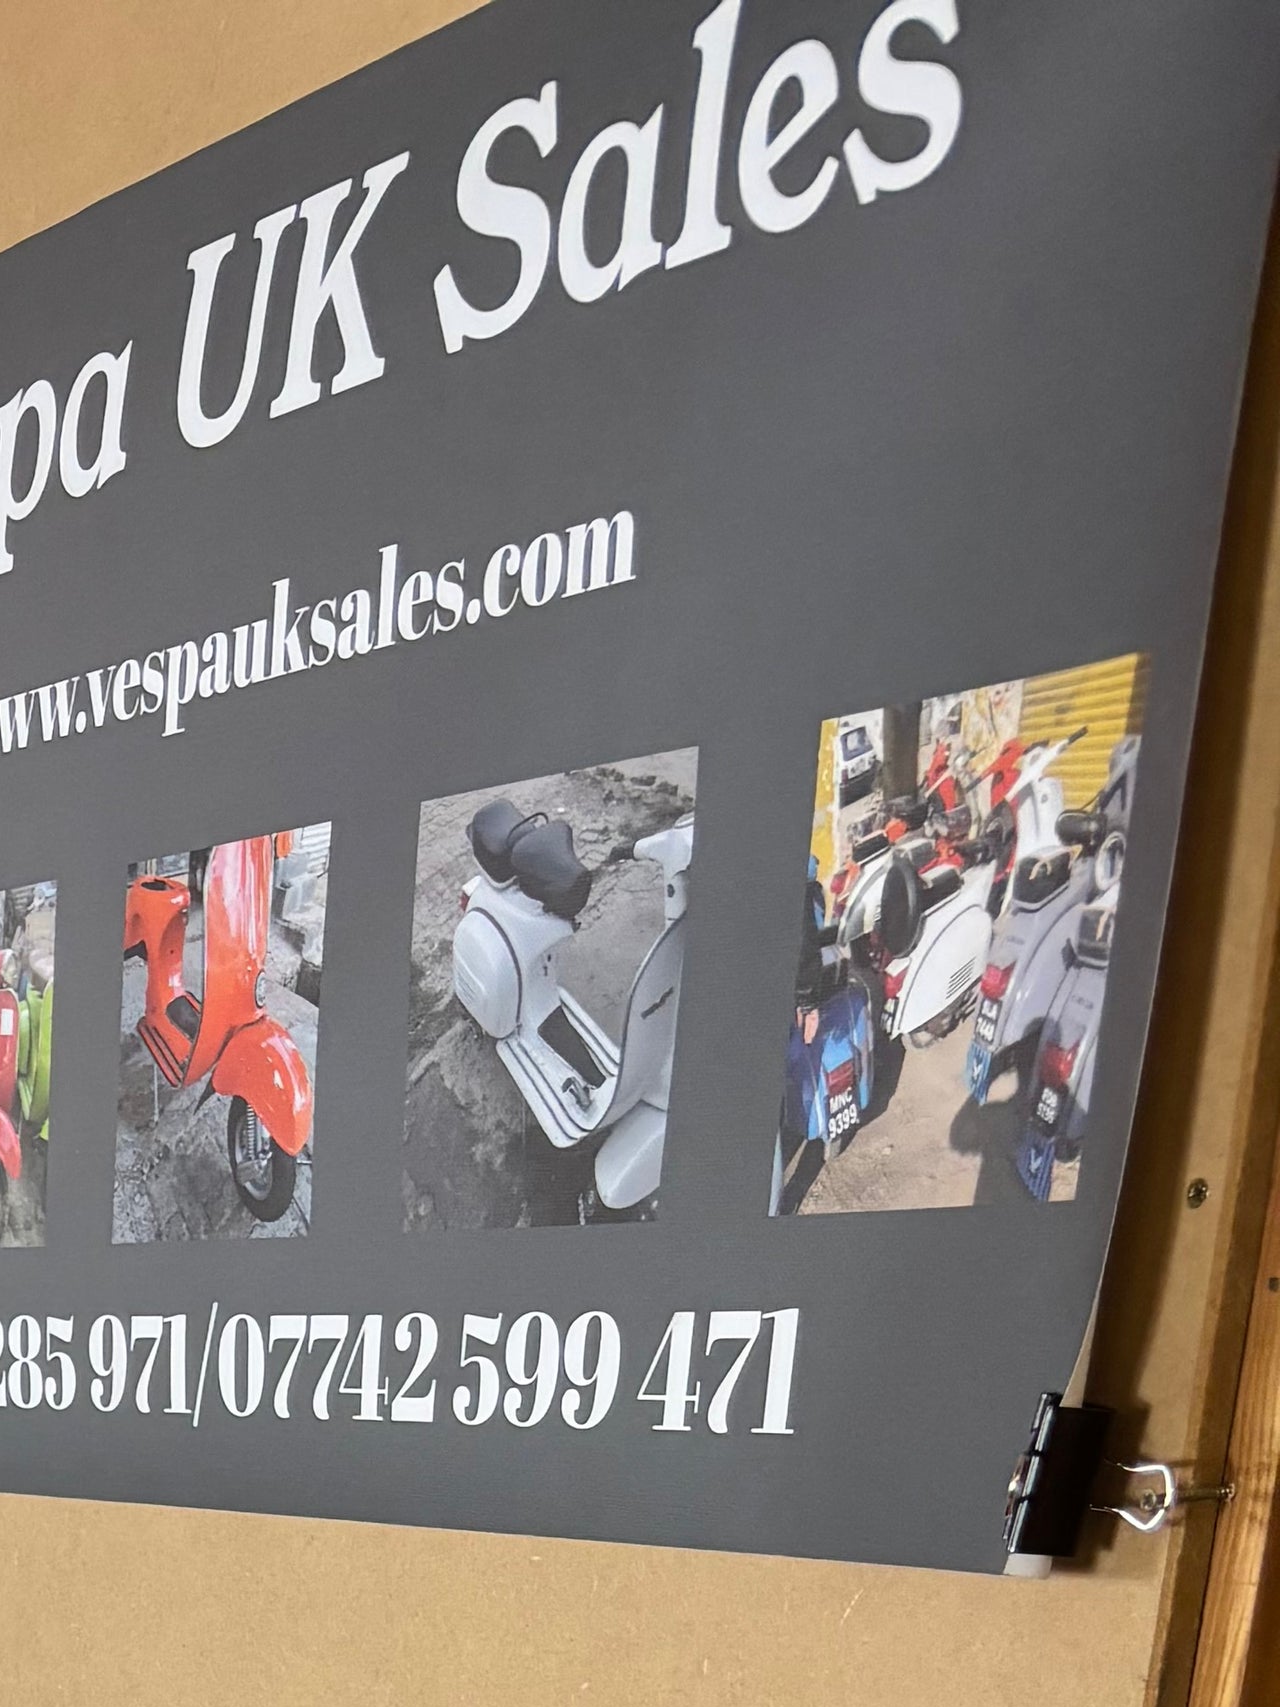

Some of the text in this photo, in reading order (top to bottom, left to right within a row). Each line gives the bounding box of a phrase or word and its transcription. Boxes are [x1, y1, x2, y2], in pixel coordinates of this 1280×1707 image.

[175, 151, 411, 449] UK
[433, 0, 964, 355] Sales
[452, 1309, 619, 1429] 599
[638, 1306, 802, 1435] 471
